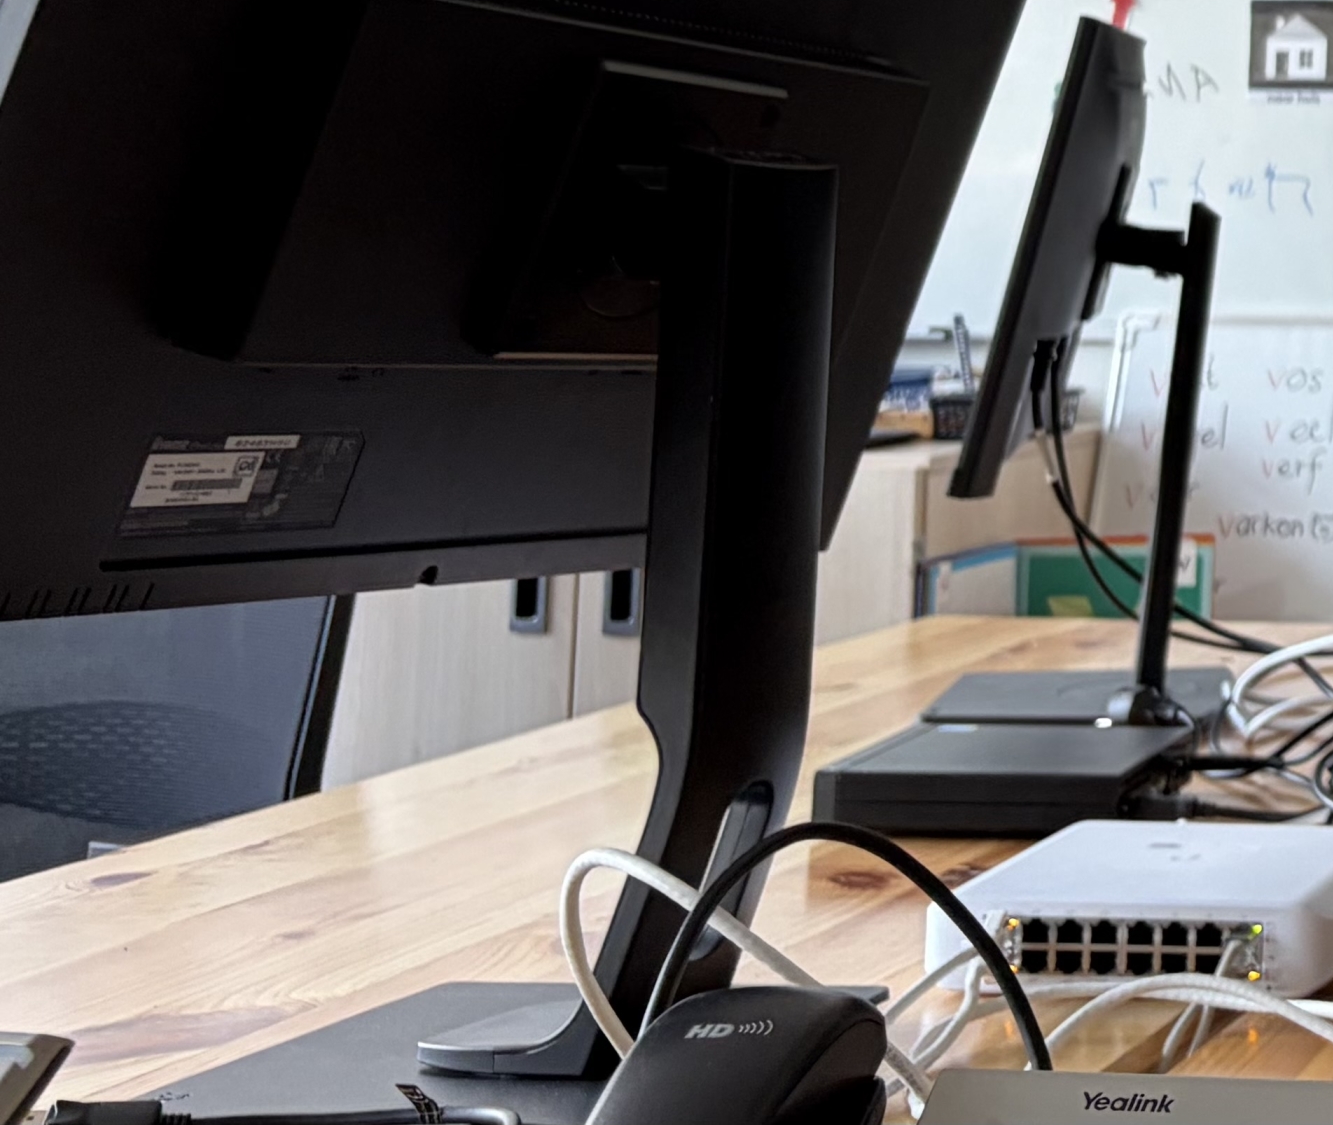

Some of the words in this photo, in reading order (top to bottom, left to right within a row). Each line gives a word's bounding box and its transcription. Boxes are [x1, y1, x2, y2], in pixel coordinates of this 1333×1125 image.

[1149, 353, 1220, 398] vt
[1267, 366, 1324, 393] vos
[1140, 400, 1230, 452] vel
[1261, 445, 1328, 497] verf
[684, 1023, 735, 1039] HD
[1083, 1091, 1175, 1114] Yealink
